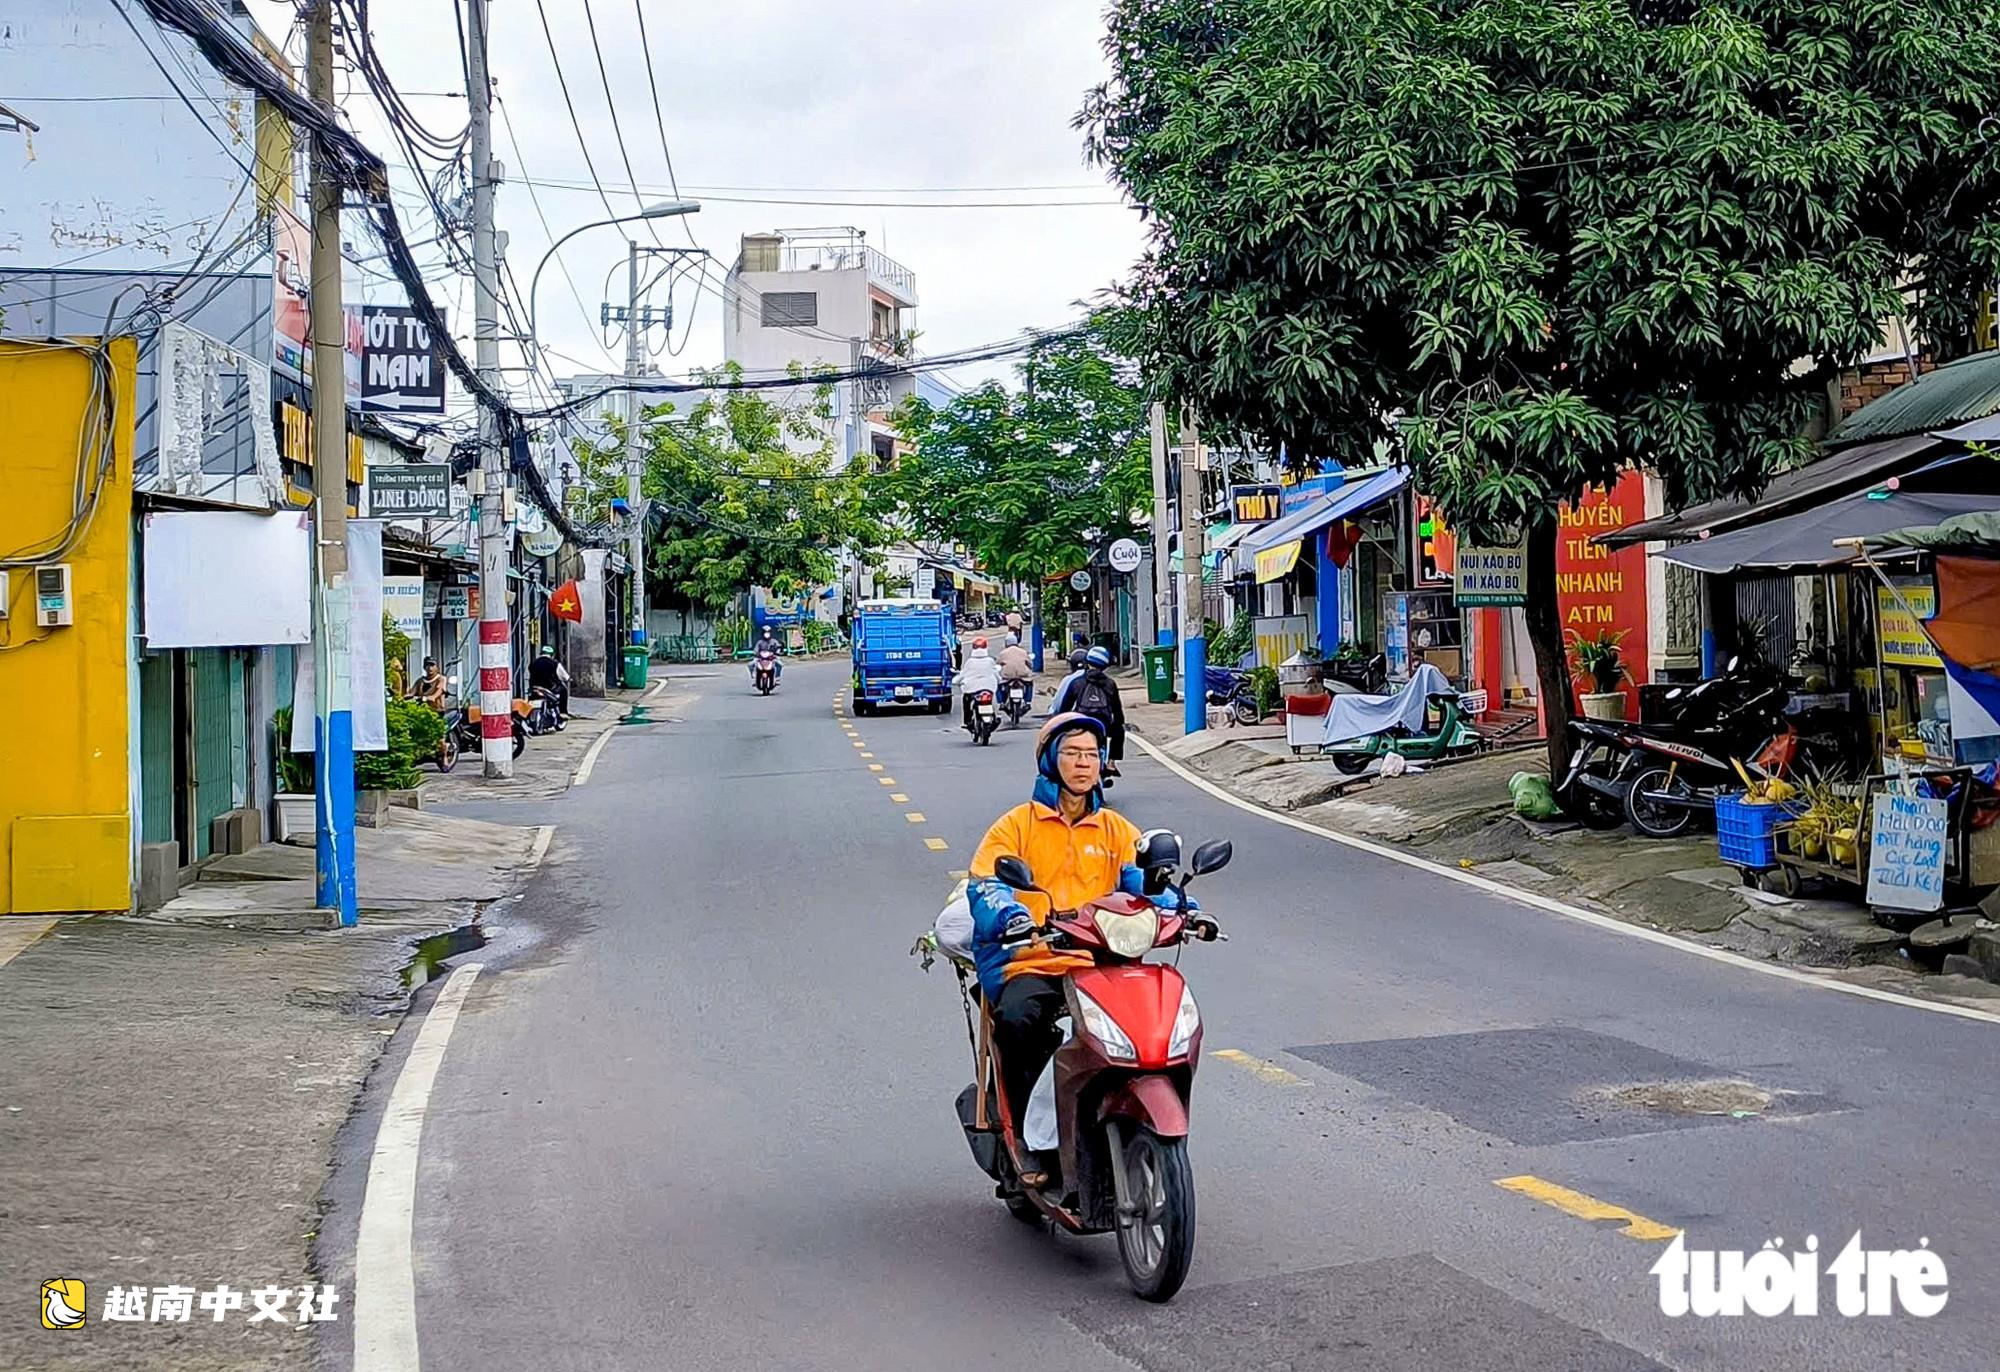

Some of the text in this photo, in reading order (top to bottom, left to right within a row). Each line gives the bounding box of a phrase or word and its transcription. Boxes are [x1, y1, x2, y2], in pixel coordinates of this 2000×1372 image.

[368, 354, 430, 390] NAM
[372, 484, 447, 508] LINH ĐÔNG
[1236, 489, 1266, 520] THÚ
[1267, 495, 1279, 518] Y
[1558, 497, 1623, 527] HUYỂN
[1460, 555, 1479, 569] NUI
[1463, 571, 1477, 589] MÌ
[1480, 572, 1501, 589] XÀO
[1556, 571, 1623, 593] NHANH
[1567, 604, 1613, 623] ATM
